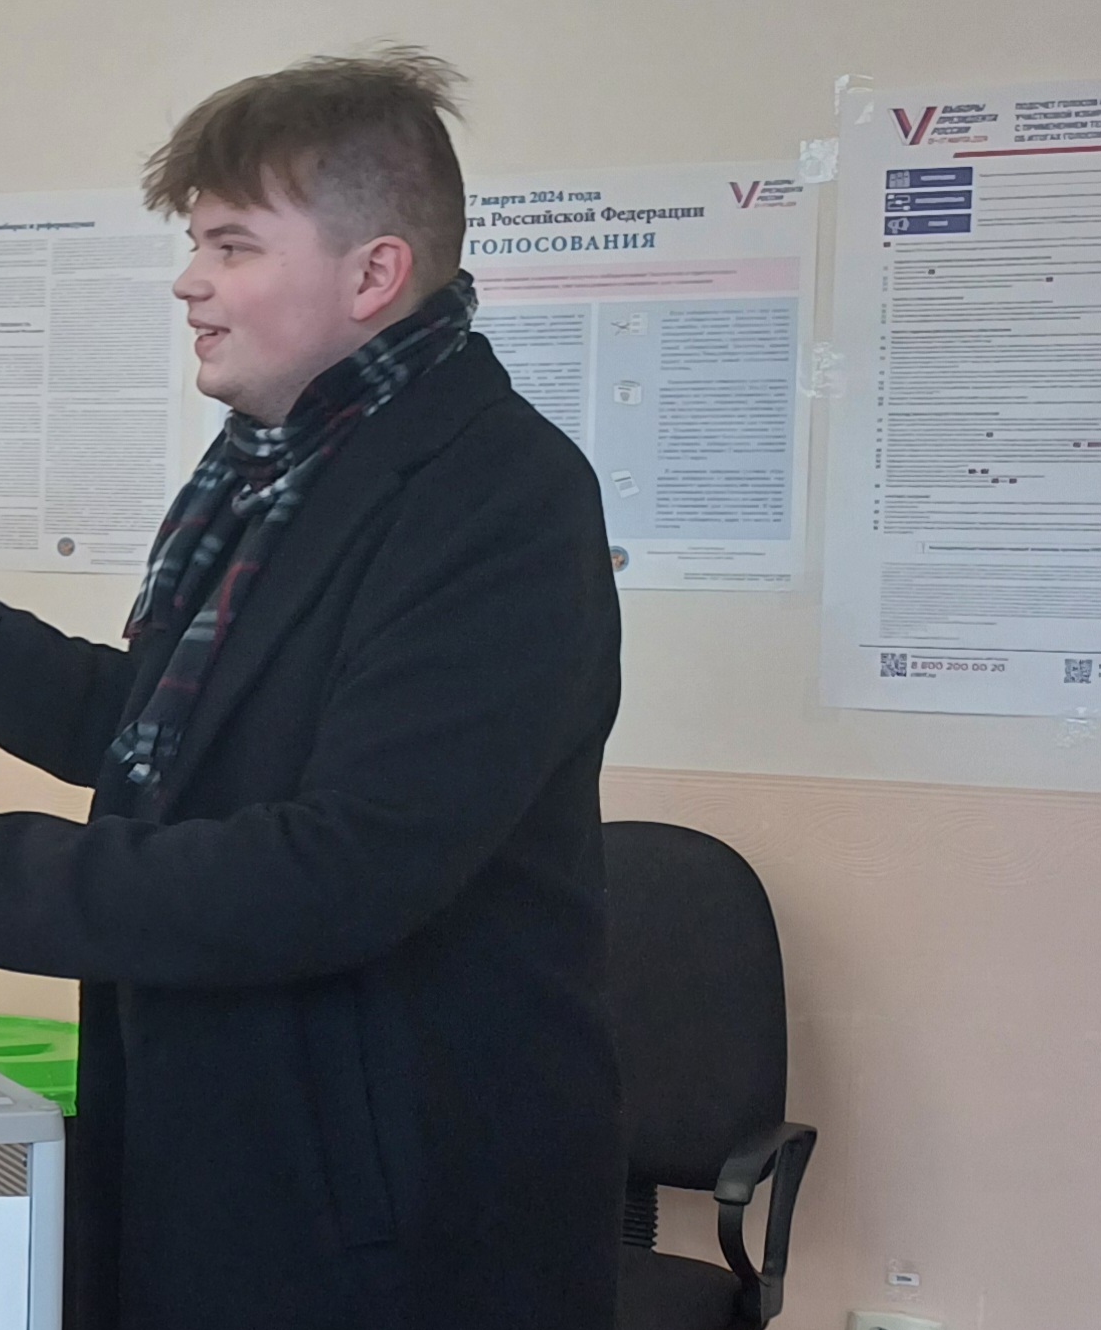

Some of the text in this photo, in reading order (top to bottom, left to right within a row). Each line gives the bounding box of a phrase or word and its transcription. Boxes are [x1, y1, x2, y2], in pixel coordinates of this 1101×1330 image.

[480, 195, 527, 209] марта
[529, 190, 565, 204] 2024
[568, 191, 602, 203] года
[490, 208, 596, 227] Российской
[600, 206, 706, 224] Федерации
[469, 232, 657, 256] ГОЛОСОВАНИЯ
[946, 662, 969, 671] 200
[971, 663, 988, 672] 00
[990, 663, 1005, 673] 20
